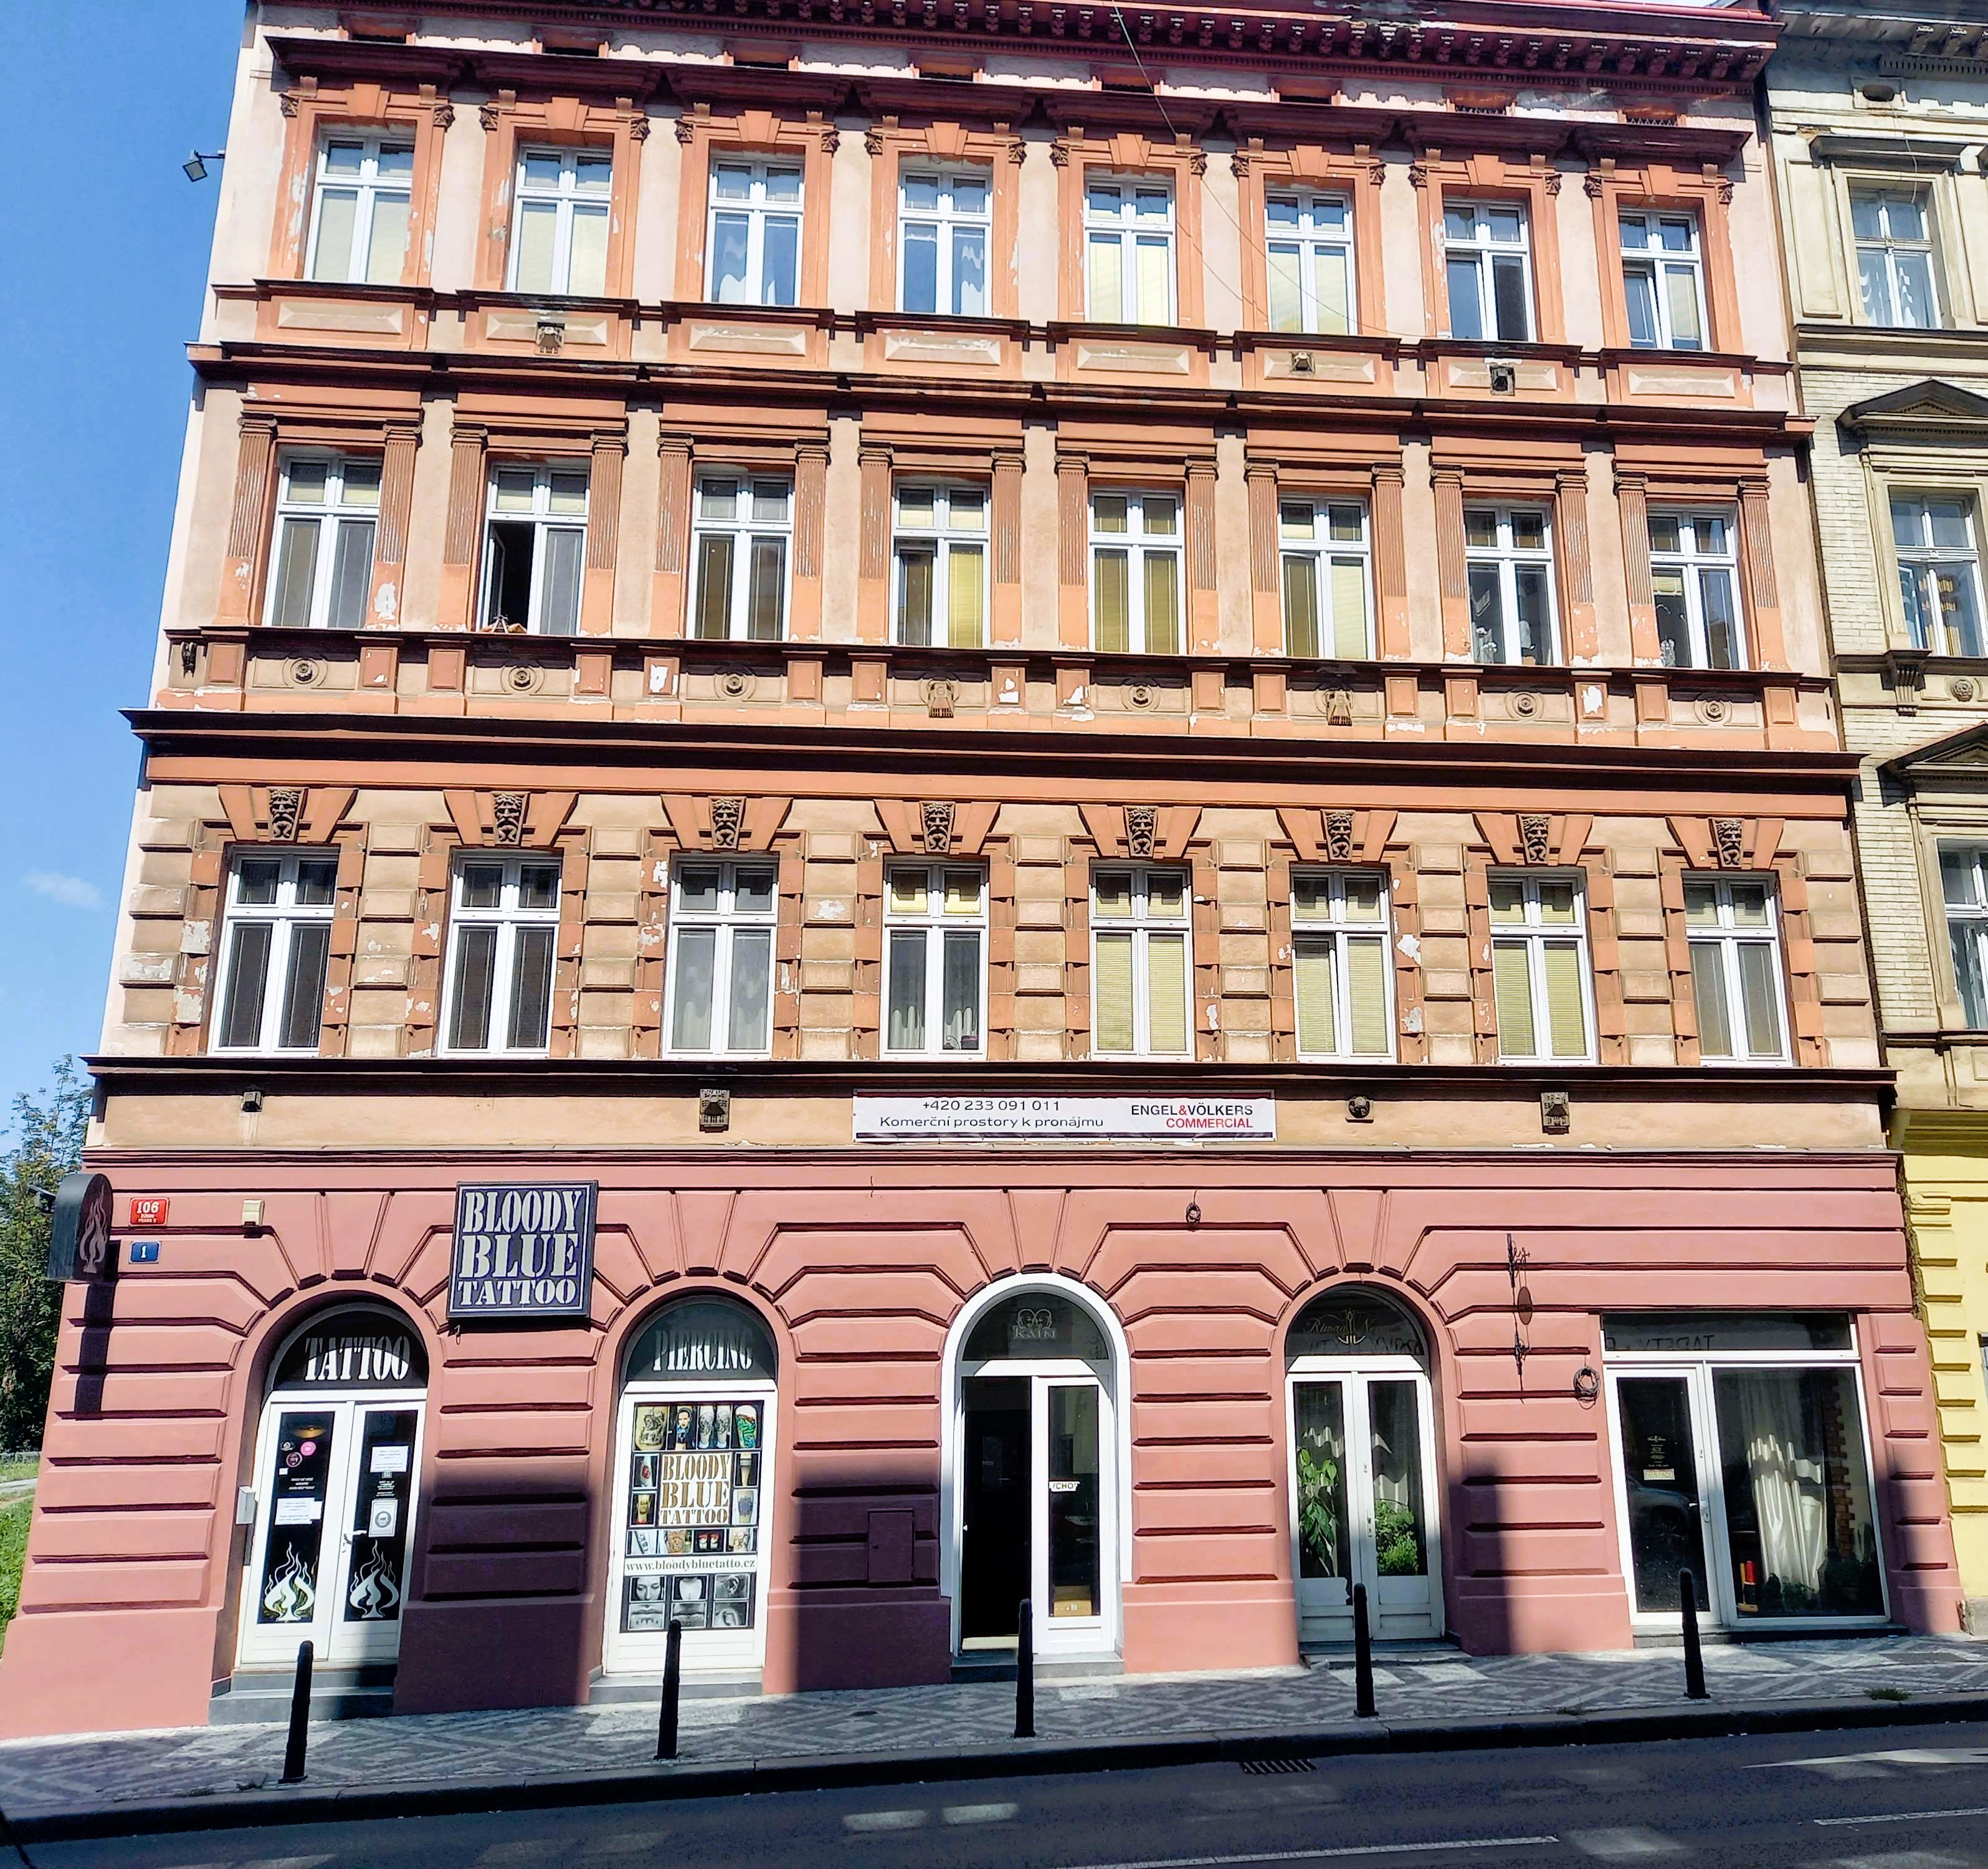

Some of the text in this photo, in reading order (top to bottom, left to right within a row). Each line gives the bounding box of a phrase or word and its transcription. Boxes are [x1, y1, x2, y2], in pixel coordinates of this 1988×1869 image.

[923, 1100, 1060, 1111] +420 233 091 011
[1131, 1103, 1253, 1115] ENGEL&VÖLKERS
[880, 1116, 1104, 1128] Komerční prostory k pronájmu
[1166, 1118, 1253, 1128] COMMERCIAL
[136, 1201, 159, 1214] 106
[462, 1190, 583, 1233] BLOODY
[141, 1245, 147, 1258] 1
[458, 1233, 579, 1278] BLUE
[457, 1278, 577, 1306] TATTOO
[304, 1336, 411, 1381] TATTOO
[653, 1329, 753, 1371] PIERCING
[662, 1453, 731, 1481] BLOODY
[660, 1480, 730, 1508] BLUE
[660, 1508, 728, 1524] TATTOO
